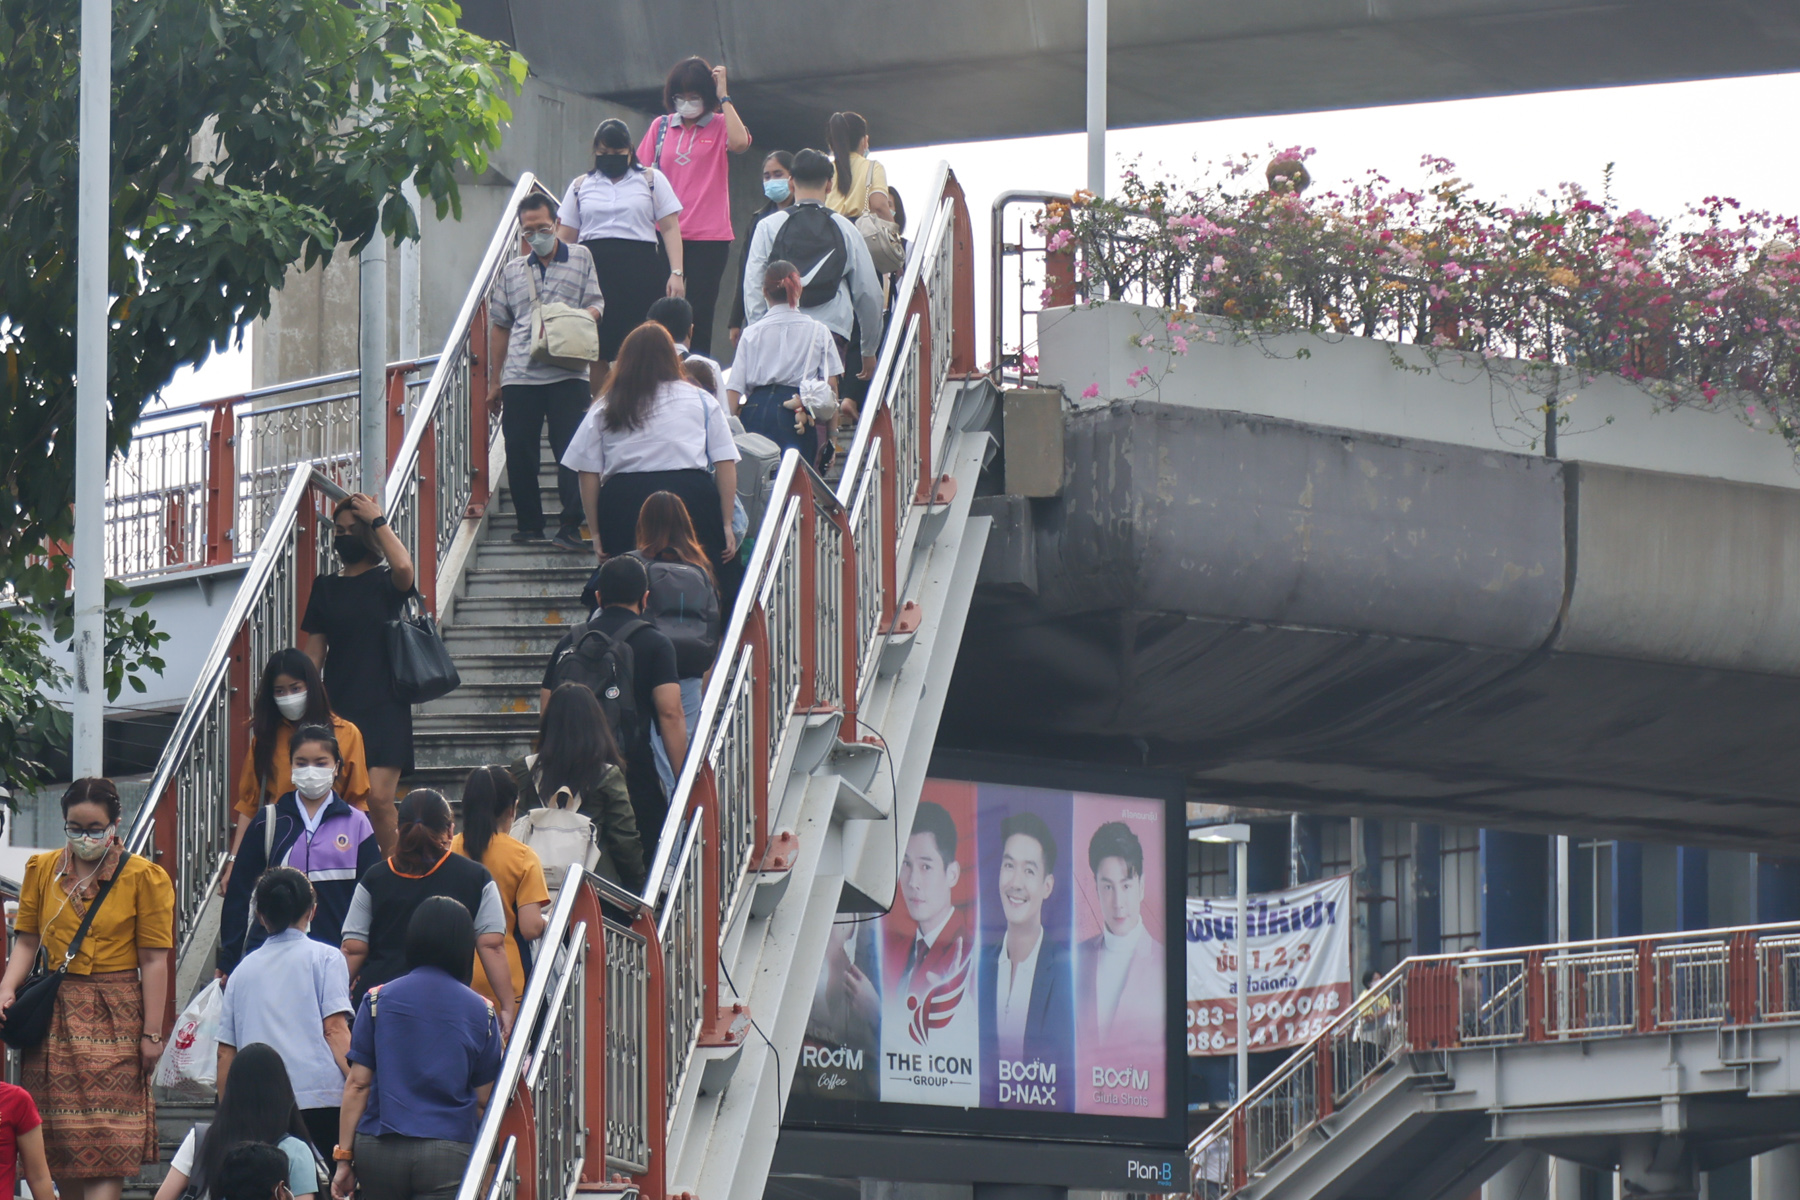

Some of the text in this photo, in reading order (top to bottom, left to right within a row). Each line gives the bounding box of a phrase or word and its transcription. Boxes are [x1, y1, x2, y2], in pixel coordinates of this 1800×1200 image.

[886, 1052, 922, 1072] THE
[817, 1073, 847, 1090] Coffee
[913, 1075, 948, 1087] GROUP
[1121, 1093, 1148, 1106] Shots
